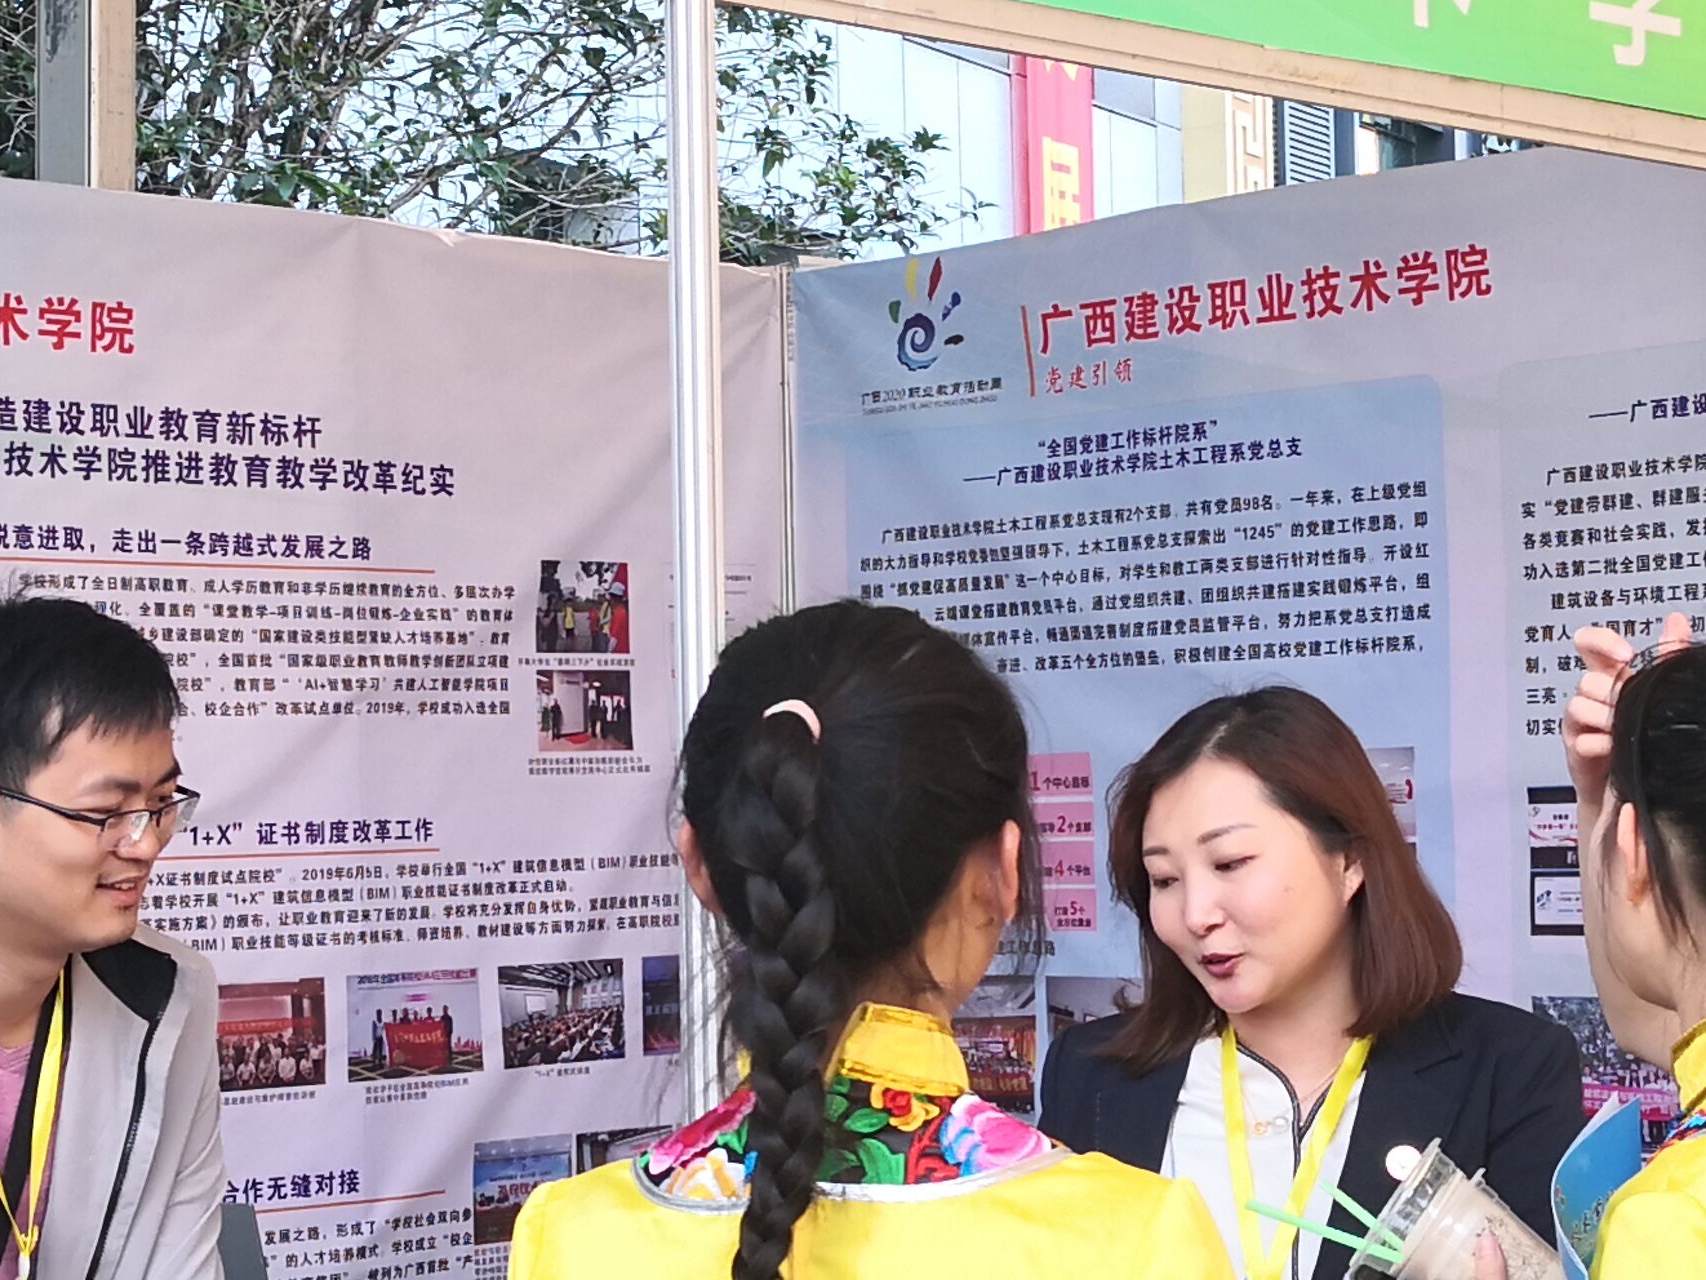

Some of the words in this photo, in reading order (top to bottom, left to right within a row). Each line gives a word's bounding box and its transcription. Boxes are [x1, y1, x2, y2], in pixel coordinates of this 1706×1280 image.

[1037, 242, 1495, 358] 广西建设职业技术学院
[1044, 359, 1135, 396] 党建引领
[1038, 419, 1219, 460] “全国党建工作标杆院系”
